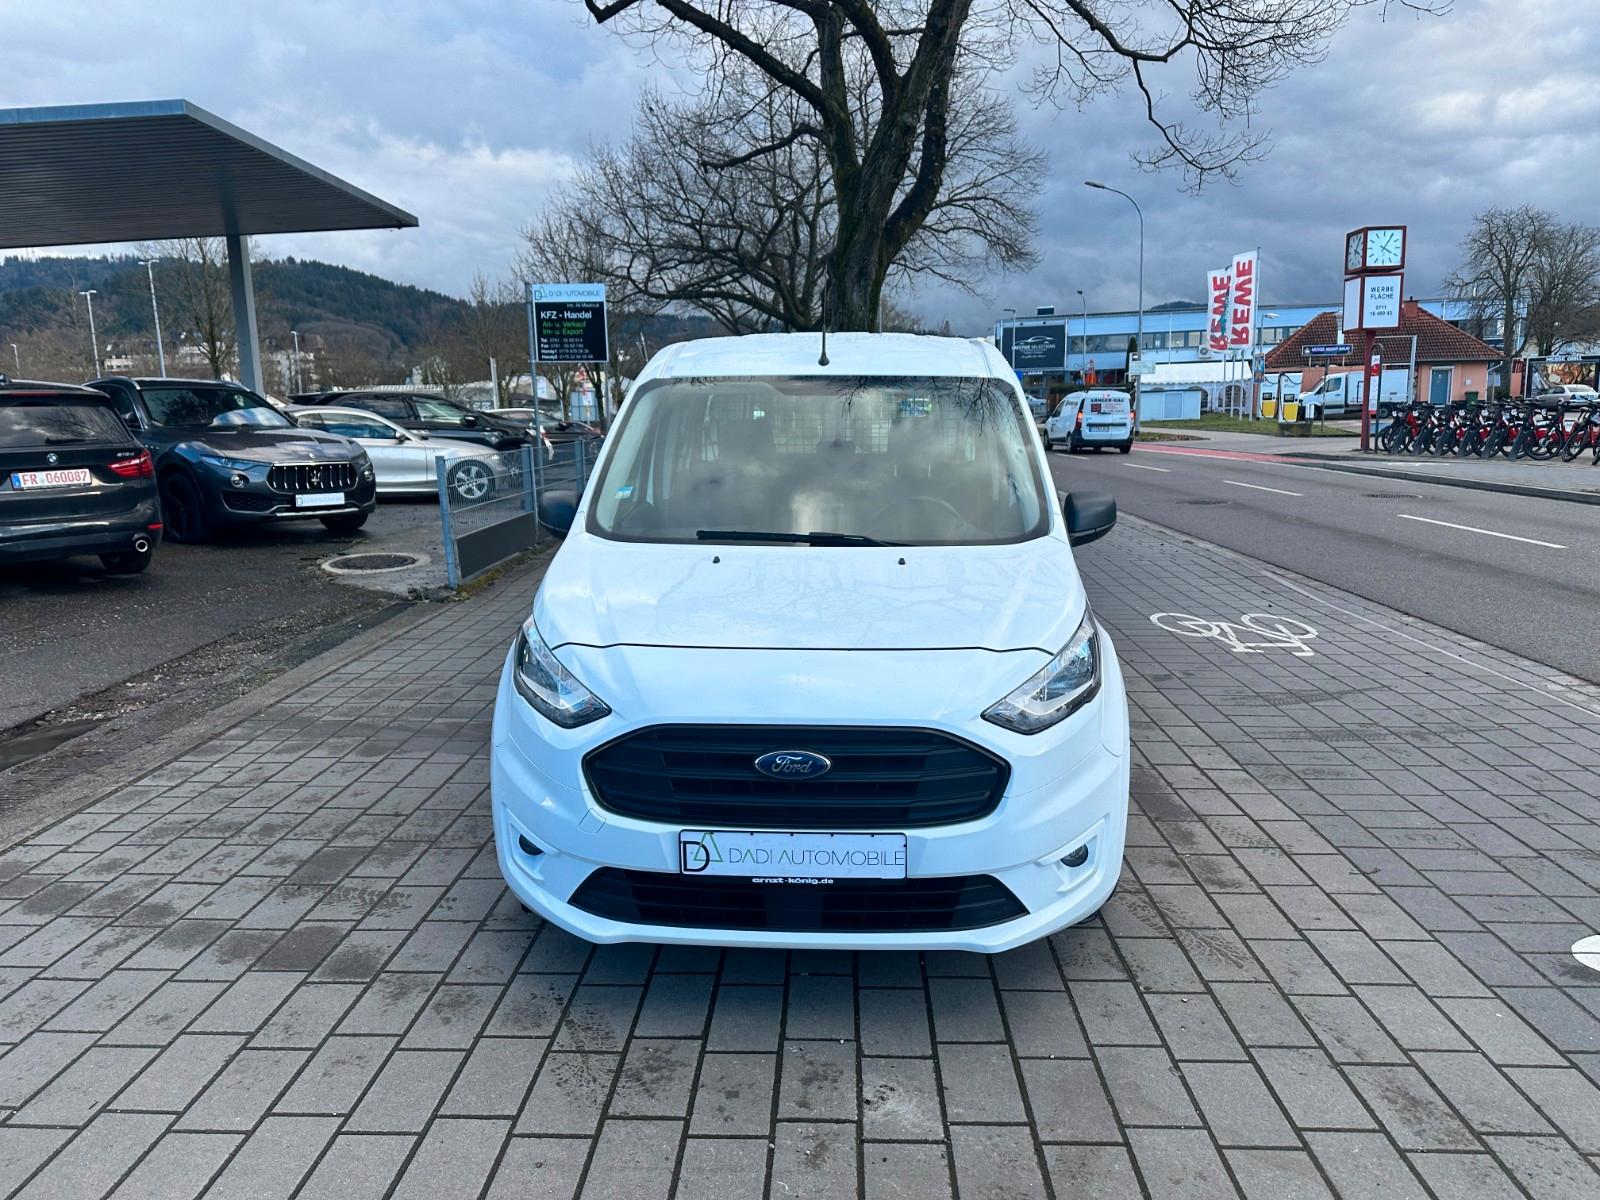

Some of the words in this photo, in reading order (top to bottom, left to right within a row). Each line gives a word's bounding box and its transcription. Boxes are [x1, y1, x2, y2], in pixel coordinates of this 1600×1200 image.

[1230, 260, 1253, 345] REWE
[540, 311, 557, 319] KFZ
[1209, 275, 1232, 351] REWE
[22, 474, 38, 485] FR
[45, 471, 88, 483] 060087
[771, 755, 813, 772] Ford
[729, 848, 773, 864] DADI
[777, 849, 905, 866] AUTOMOBILE
